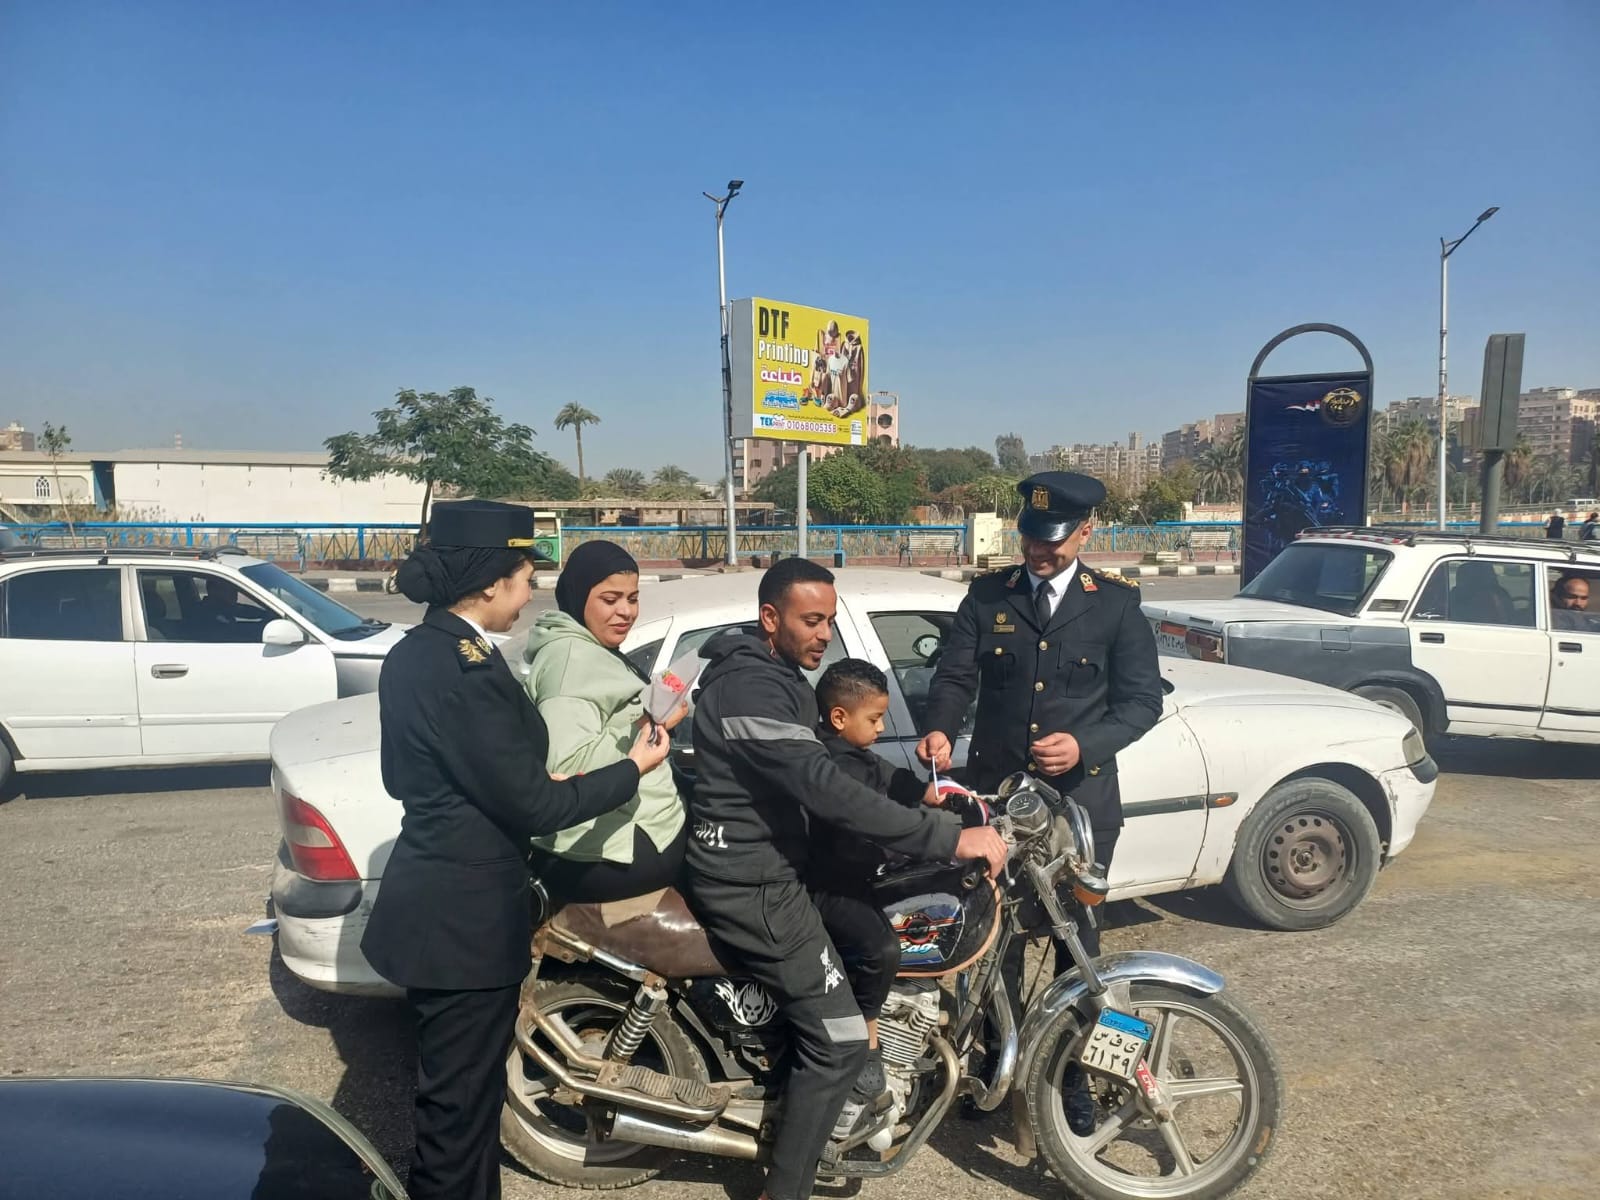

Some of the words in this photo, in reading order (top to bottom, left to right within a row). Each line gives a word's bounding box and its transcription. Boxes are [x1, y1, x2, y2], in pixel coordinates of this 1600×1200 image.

[759, 306, 790, 340] DTF
[758, 340, 809, 367] Printing
[760, 364, 803, 387] طباعة
[760, 416, 773, 426] TEX
